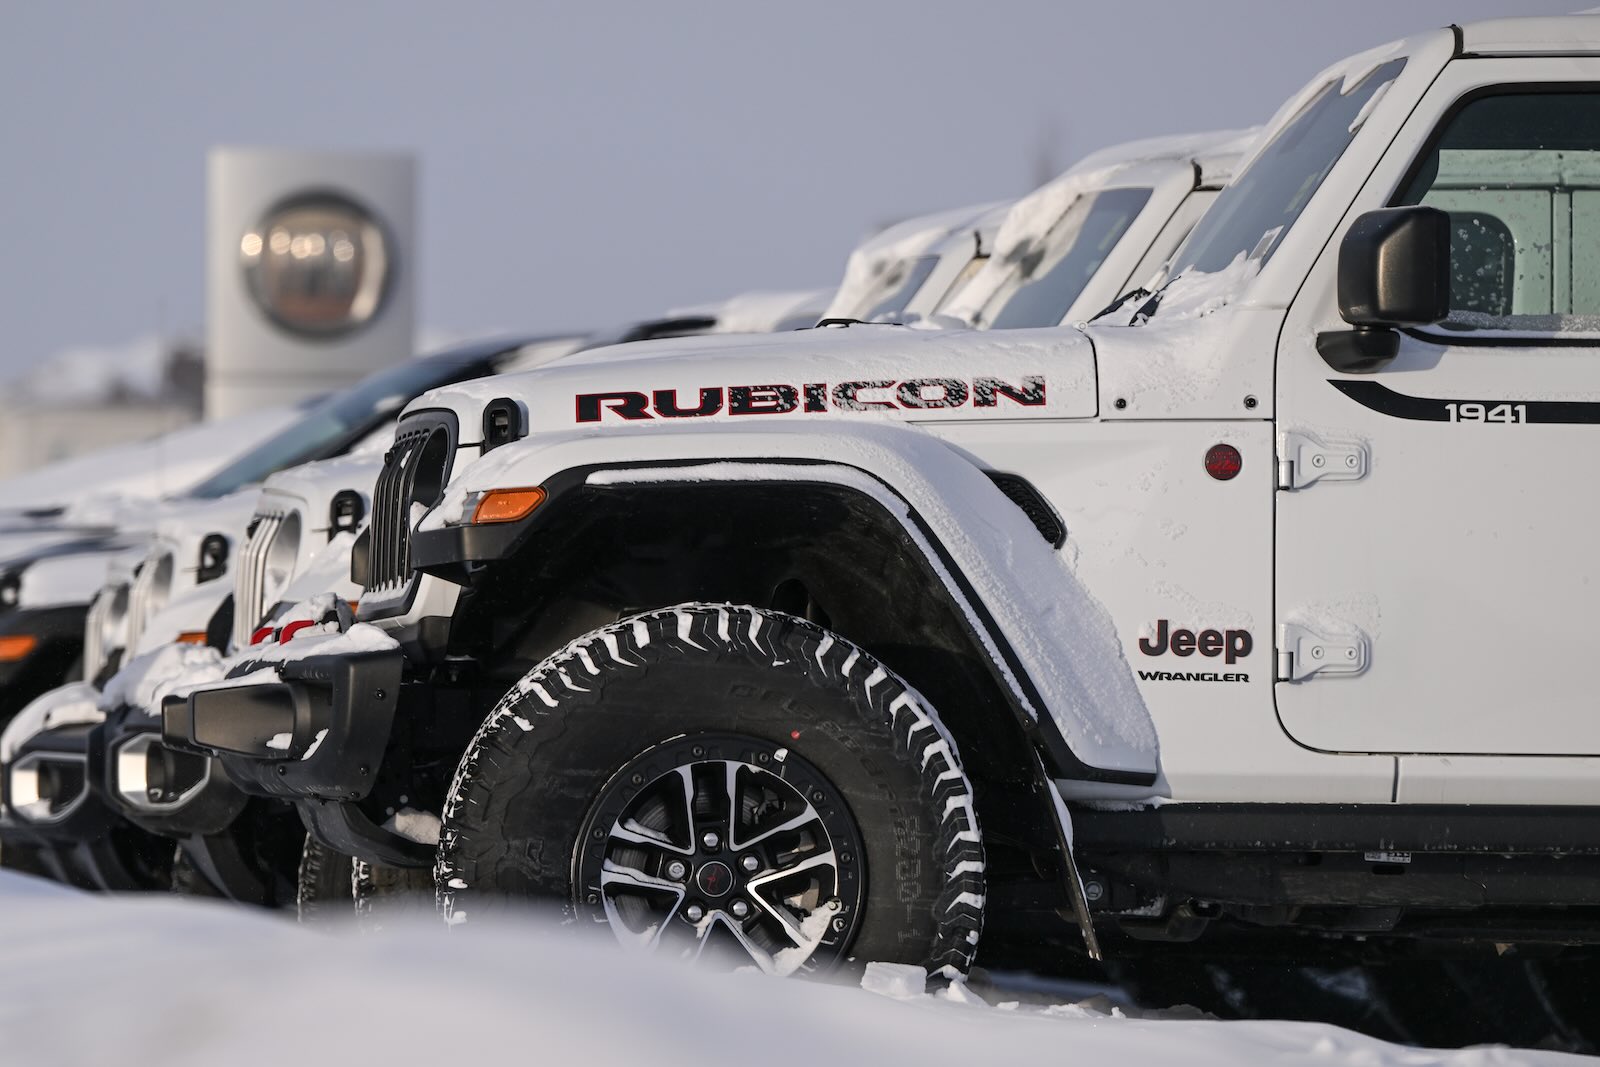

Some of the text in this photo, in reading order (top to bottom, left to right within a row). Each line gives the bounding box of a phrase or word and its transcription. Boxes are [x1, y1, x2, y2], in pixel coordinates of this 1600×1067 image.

[576, 376, 1046, 423] RUBICON
[1445, 403, 1527, 423] 1941
[1138, 619, 1253, 665] Jeep
[1138, 670, 1249, 682] WRANGLER
